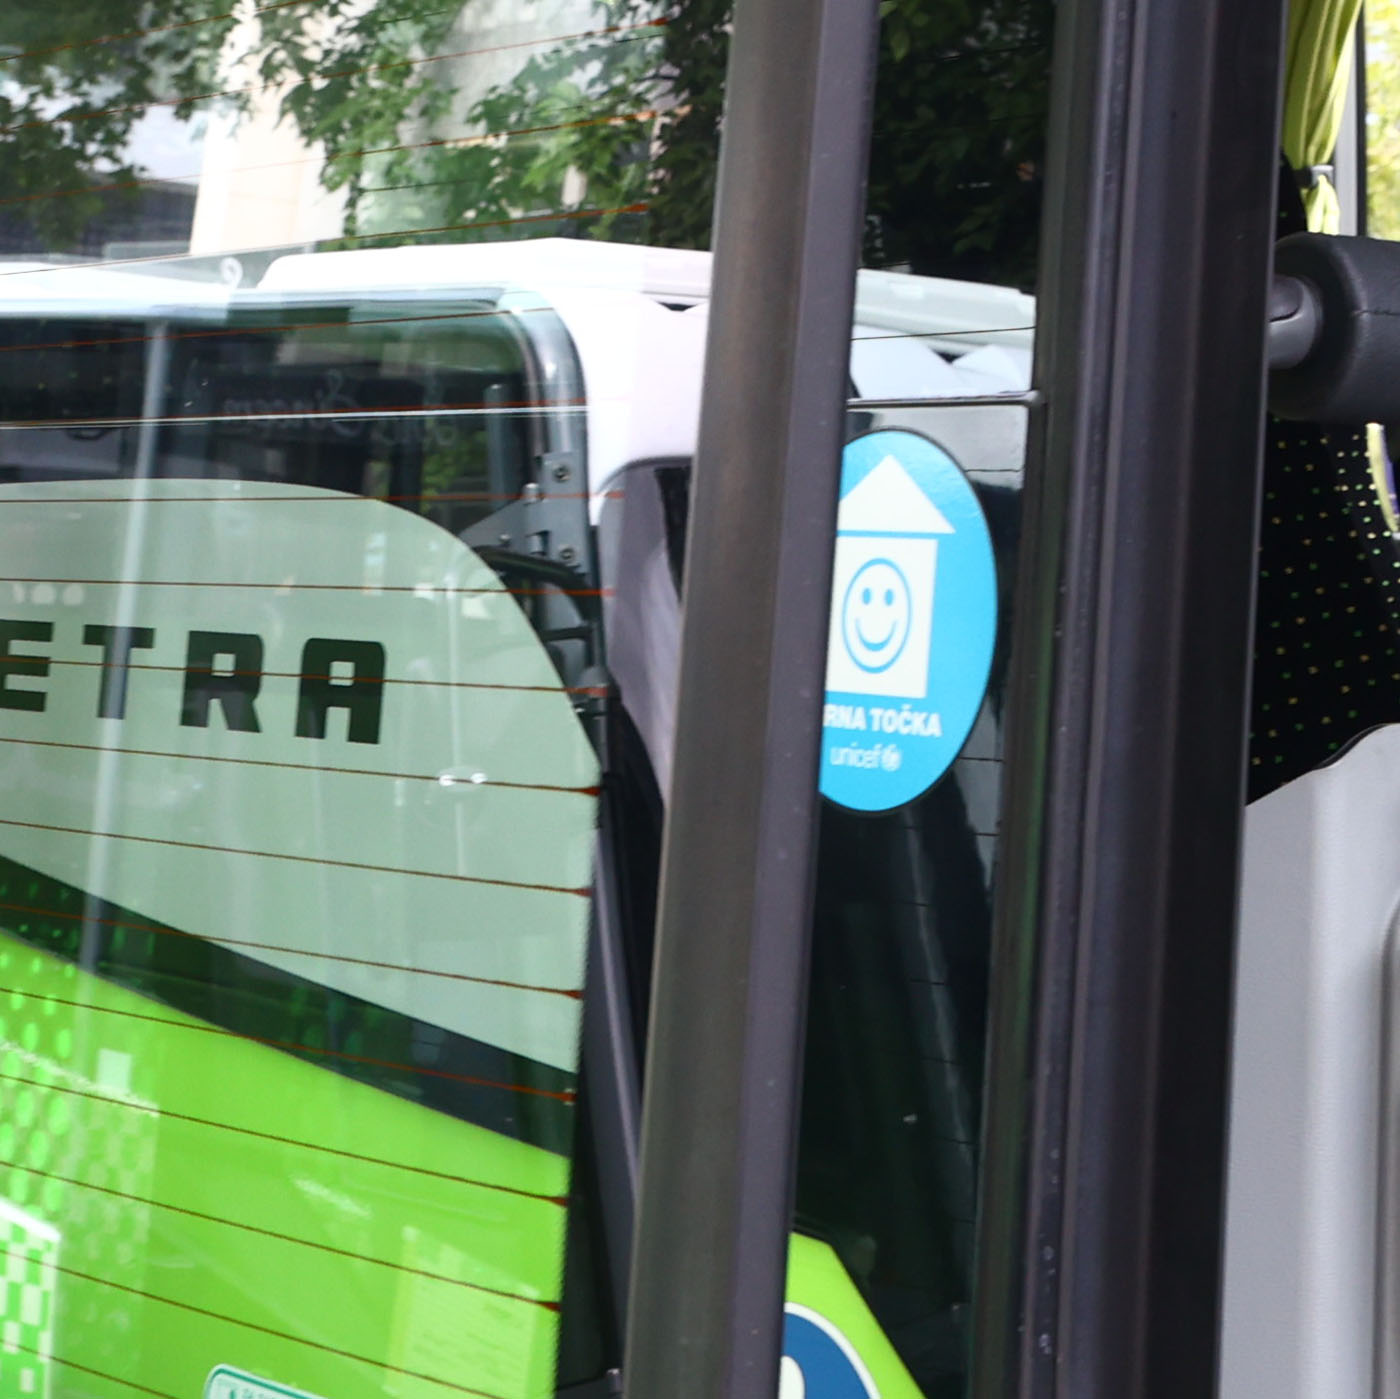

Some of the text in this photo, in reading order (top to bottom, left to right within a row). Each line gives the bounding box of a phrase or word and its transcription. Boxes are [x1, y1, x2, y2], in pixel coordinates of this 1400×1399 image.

[0, 619, 385, 744] ETRA
[870, 703, 943, 737] TOČKA
[830, 741, 882, 769] unicef
